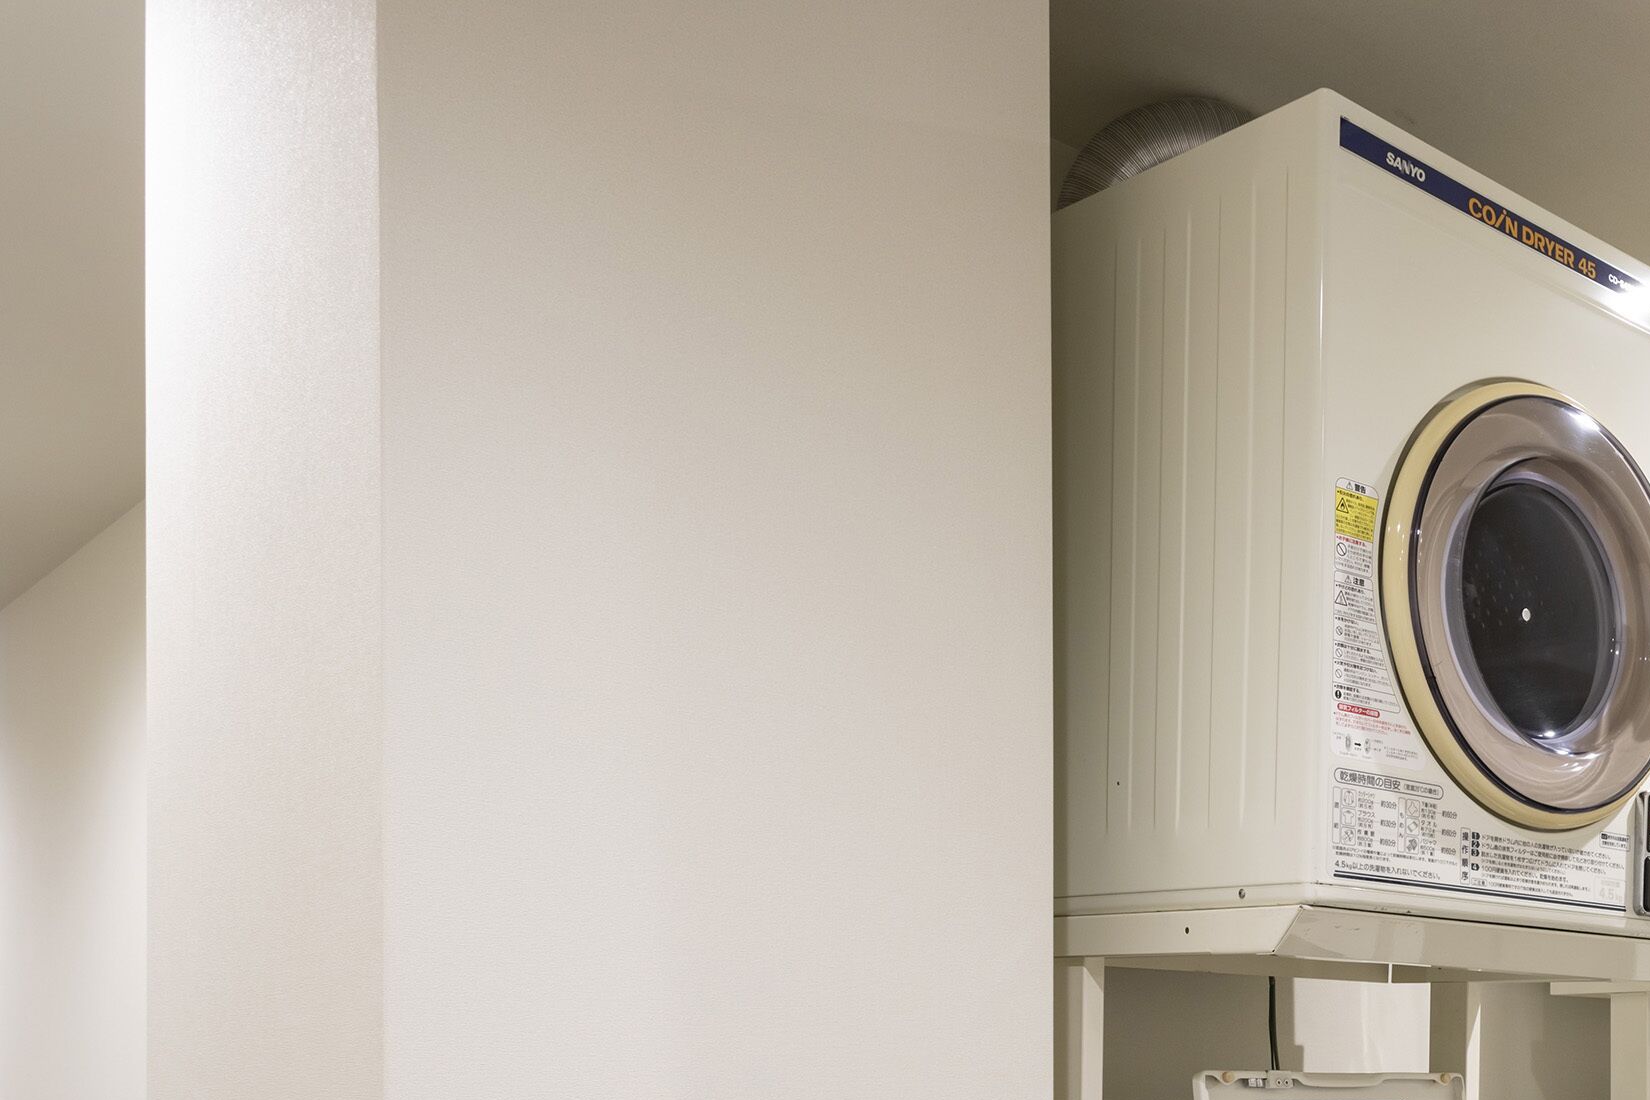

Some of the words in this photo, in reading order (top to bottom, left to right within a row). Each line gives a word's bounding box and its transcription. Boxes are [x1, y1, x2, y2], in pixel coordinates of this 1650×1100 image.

[1386, 151, 1426, 182] SANYO
[1522, 224, 1575, 268] DRYER
[1578, 257, 1597, 279] 45
[1340, 770, 1401, 790] 乾燥時間の目安
